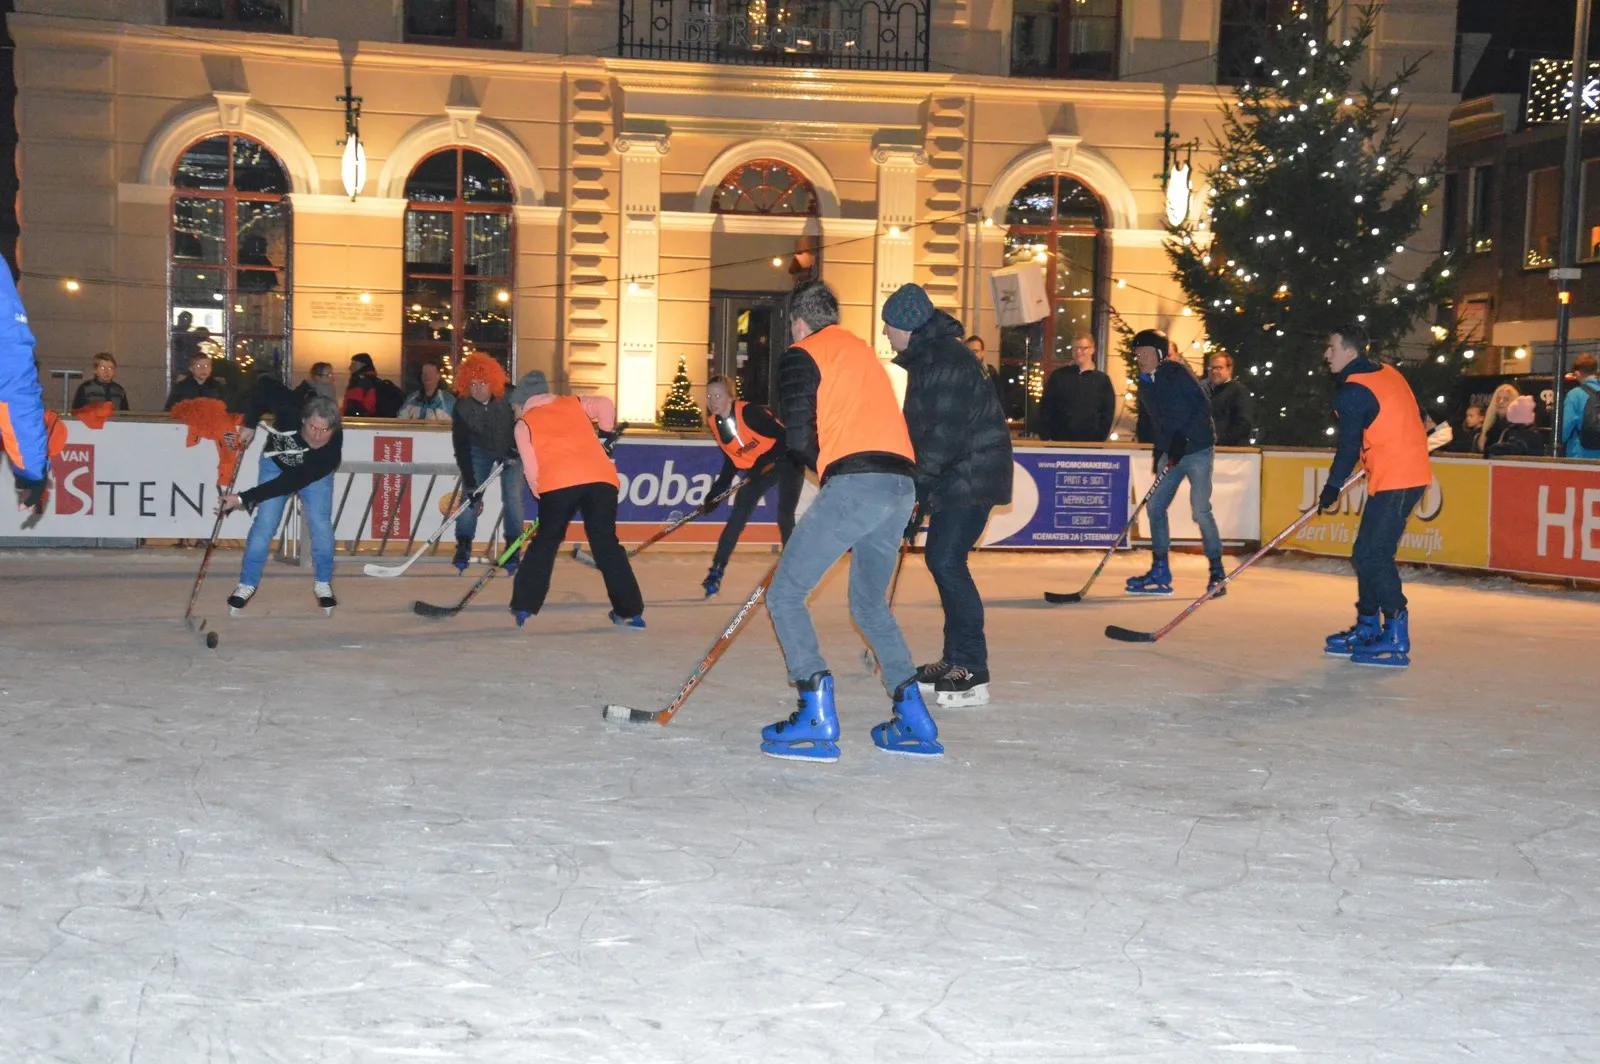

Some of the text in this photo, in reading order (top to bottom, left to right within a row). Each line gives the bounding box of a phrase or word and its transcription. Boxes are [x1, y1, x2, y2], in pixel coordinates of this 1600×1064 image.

[682, 15, 862, 50] DE RECHTER
[60, 450, 90, 462] VAN
[1145, 465, 1170, 501] BAUER
[1063, 495, 1104, 505] WERKKLEDING
[1072, 515, 1094, 525] DESIGN
[1330, 522, 1349, 543] Vis
[722, 586, 766, 639] RESPONSE
